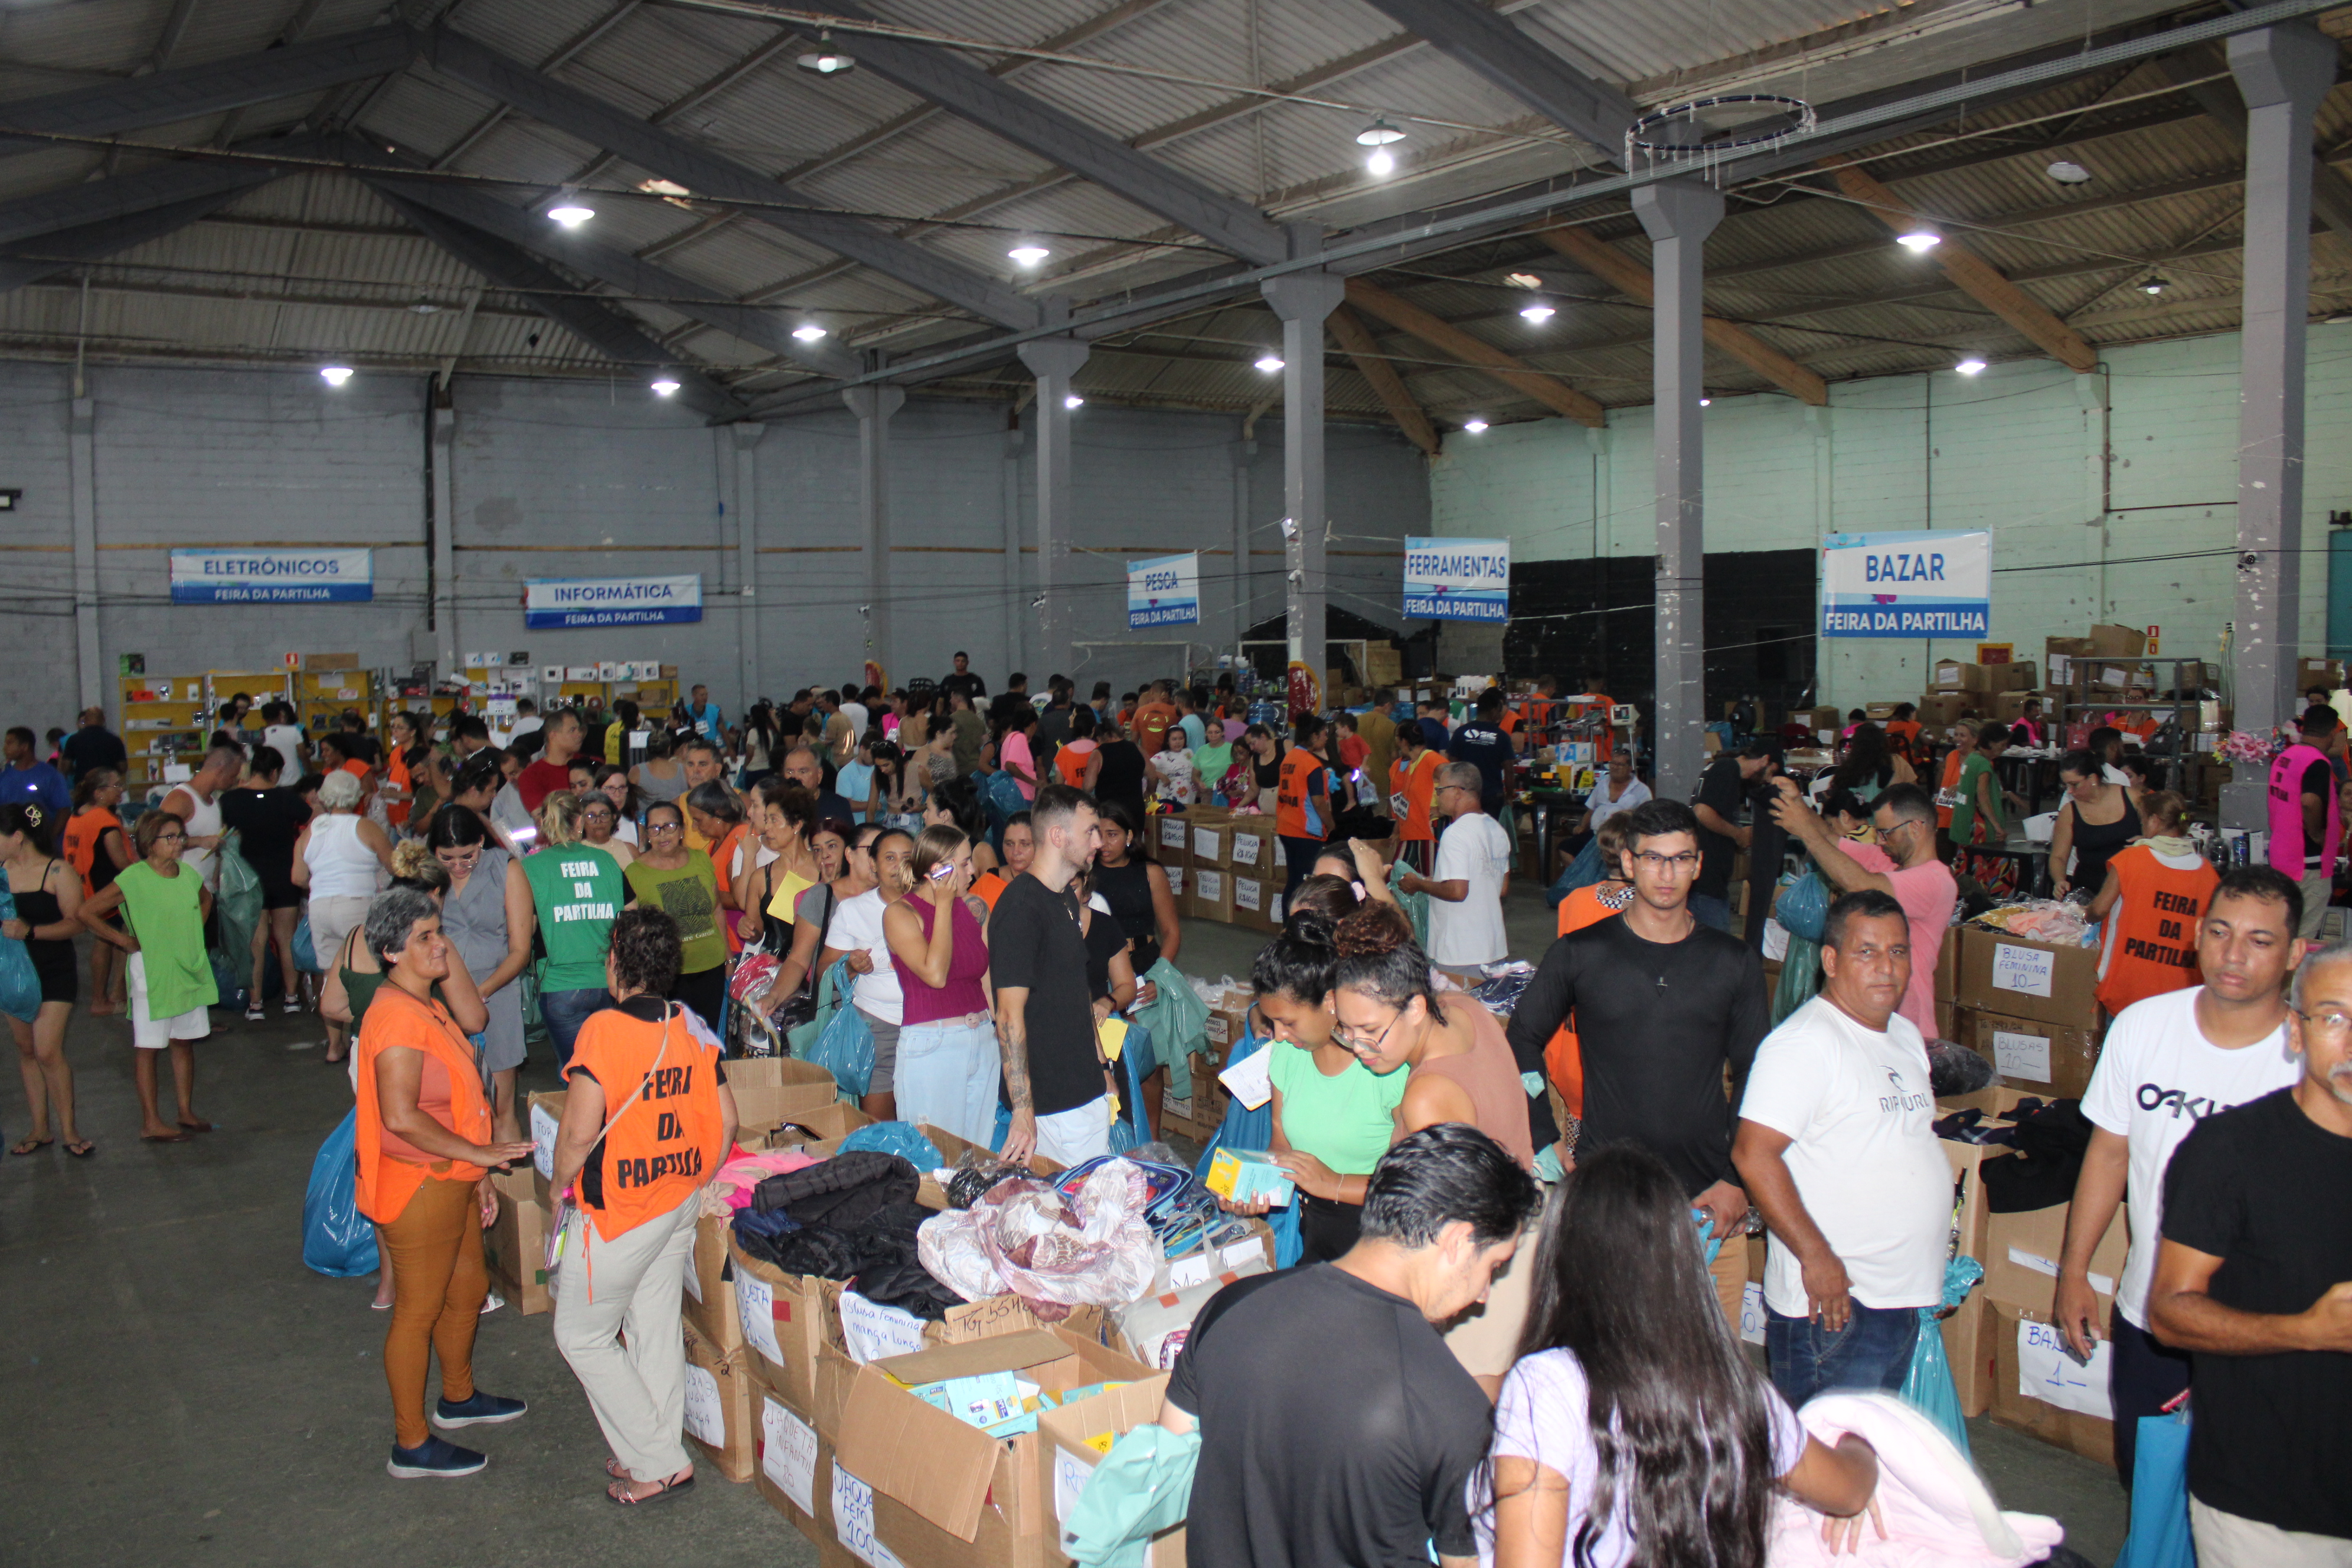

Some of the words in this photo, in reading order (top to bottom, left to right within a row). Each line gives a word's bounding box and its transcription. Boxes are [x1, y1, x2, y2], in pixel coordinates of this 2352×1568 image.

[204, 557, 339, 574] ELETRÔNICOS
[1408, 554, 1505, 578] FERRAMENTAS
[1866, 553, 1945, 582] BAZAR
[1146, 571, 1178, 592] PESCA
[215, 589, 249, 600] FEIRA
[252, 589, 268, 599] DA
[272, 588, 330, 599] PARTILHA
[554, 583, 673, 602] INFORMÁTICA
[565, 614, 595, 625] FEIRA
[597, 613, 612, 623] DA
[615, 611, 665, 622] PARTILHA
[1131, 612, 1150, 625] FEIRA
[1150, 611, 1162, 623] DA
[1162, 606, 1196, 622] PARTILHA
[1406, 599, 1435, 614] FEIRA
[1436, 600, 1452, 615] DA
[1453, 601, 1505, 618] PARTILHA
[1825, 612, 1872, 630] FEIRA
[1874, 612, 1899, 630] DA
[1902, 612, 1985, 631] PARTILHA
[560, 861, 599, 878] FEIRA
[574, 881, 593, 899] DA
[553, 903, 615, 923] PARTILHA
[2154, 890, 2197, 917] FEIRA
[2158, 919, 2181, 940] DA
[2003, 948, 2040, 961] BLUSA
[1999, 961, 2047, 976] FEMININA
[1998, 1037, 2044, 1051] BLUSAS
[1879, 1096, 1899, 1113] RIP
[536, 1121, 551, 1138] TOP
[844, 1299, 875, 1319] Blusa
[852, 1322, 887, 1346] manga
[766, 1406, 814, 1456] JAQUETA
